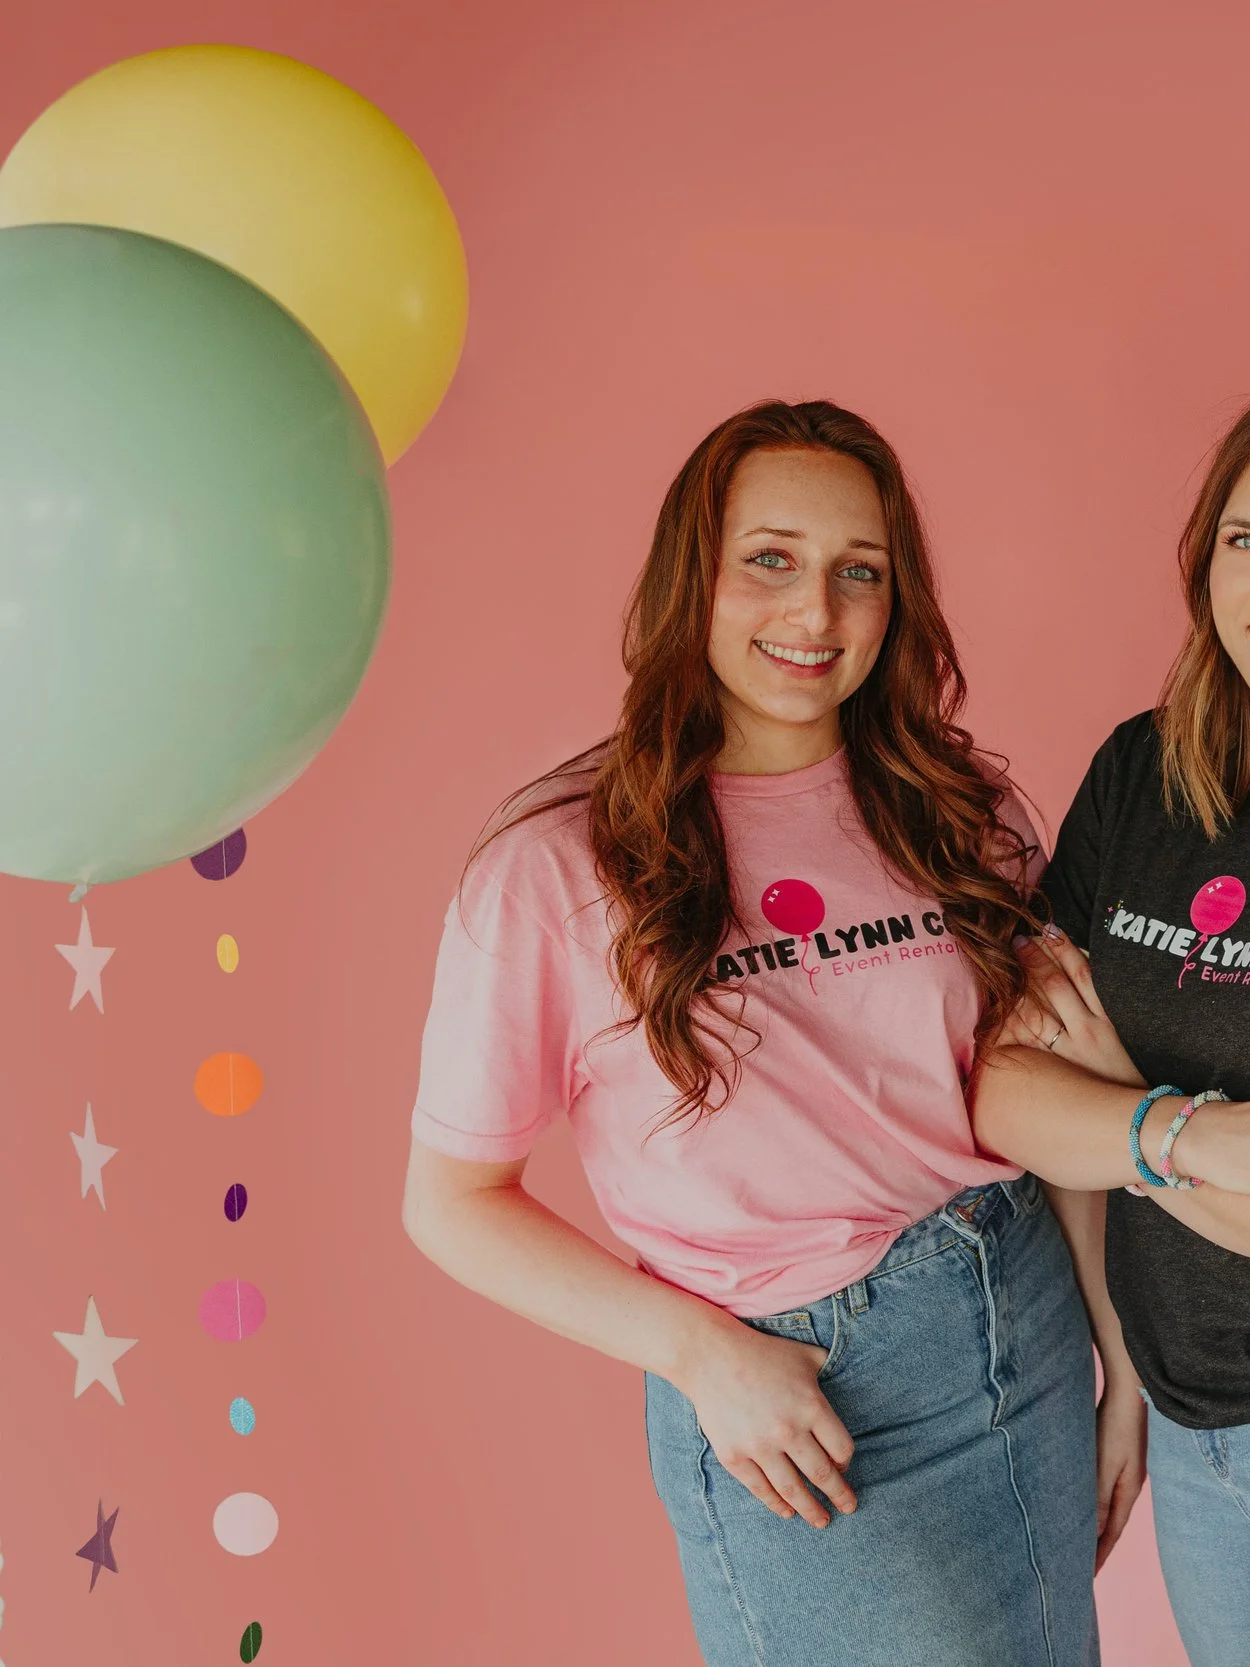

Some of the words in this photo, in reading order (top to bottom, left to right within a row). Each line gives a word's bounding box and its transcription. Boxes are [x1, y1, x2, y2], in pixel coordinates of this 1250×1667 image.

[703, 937, 801, 984] ATIE
[815, 913, 916, 960] LYNN
[1109, 908, 1197, 957] KATIE
[832, 952, 891, 977] Event
[898, 940, 960, 961] Rental
[1201, 965, 1241, 984] Event
